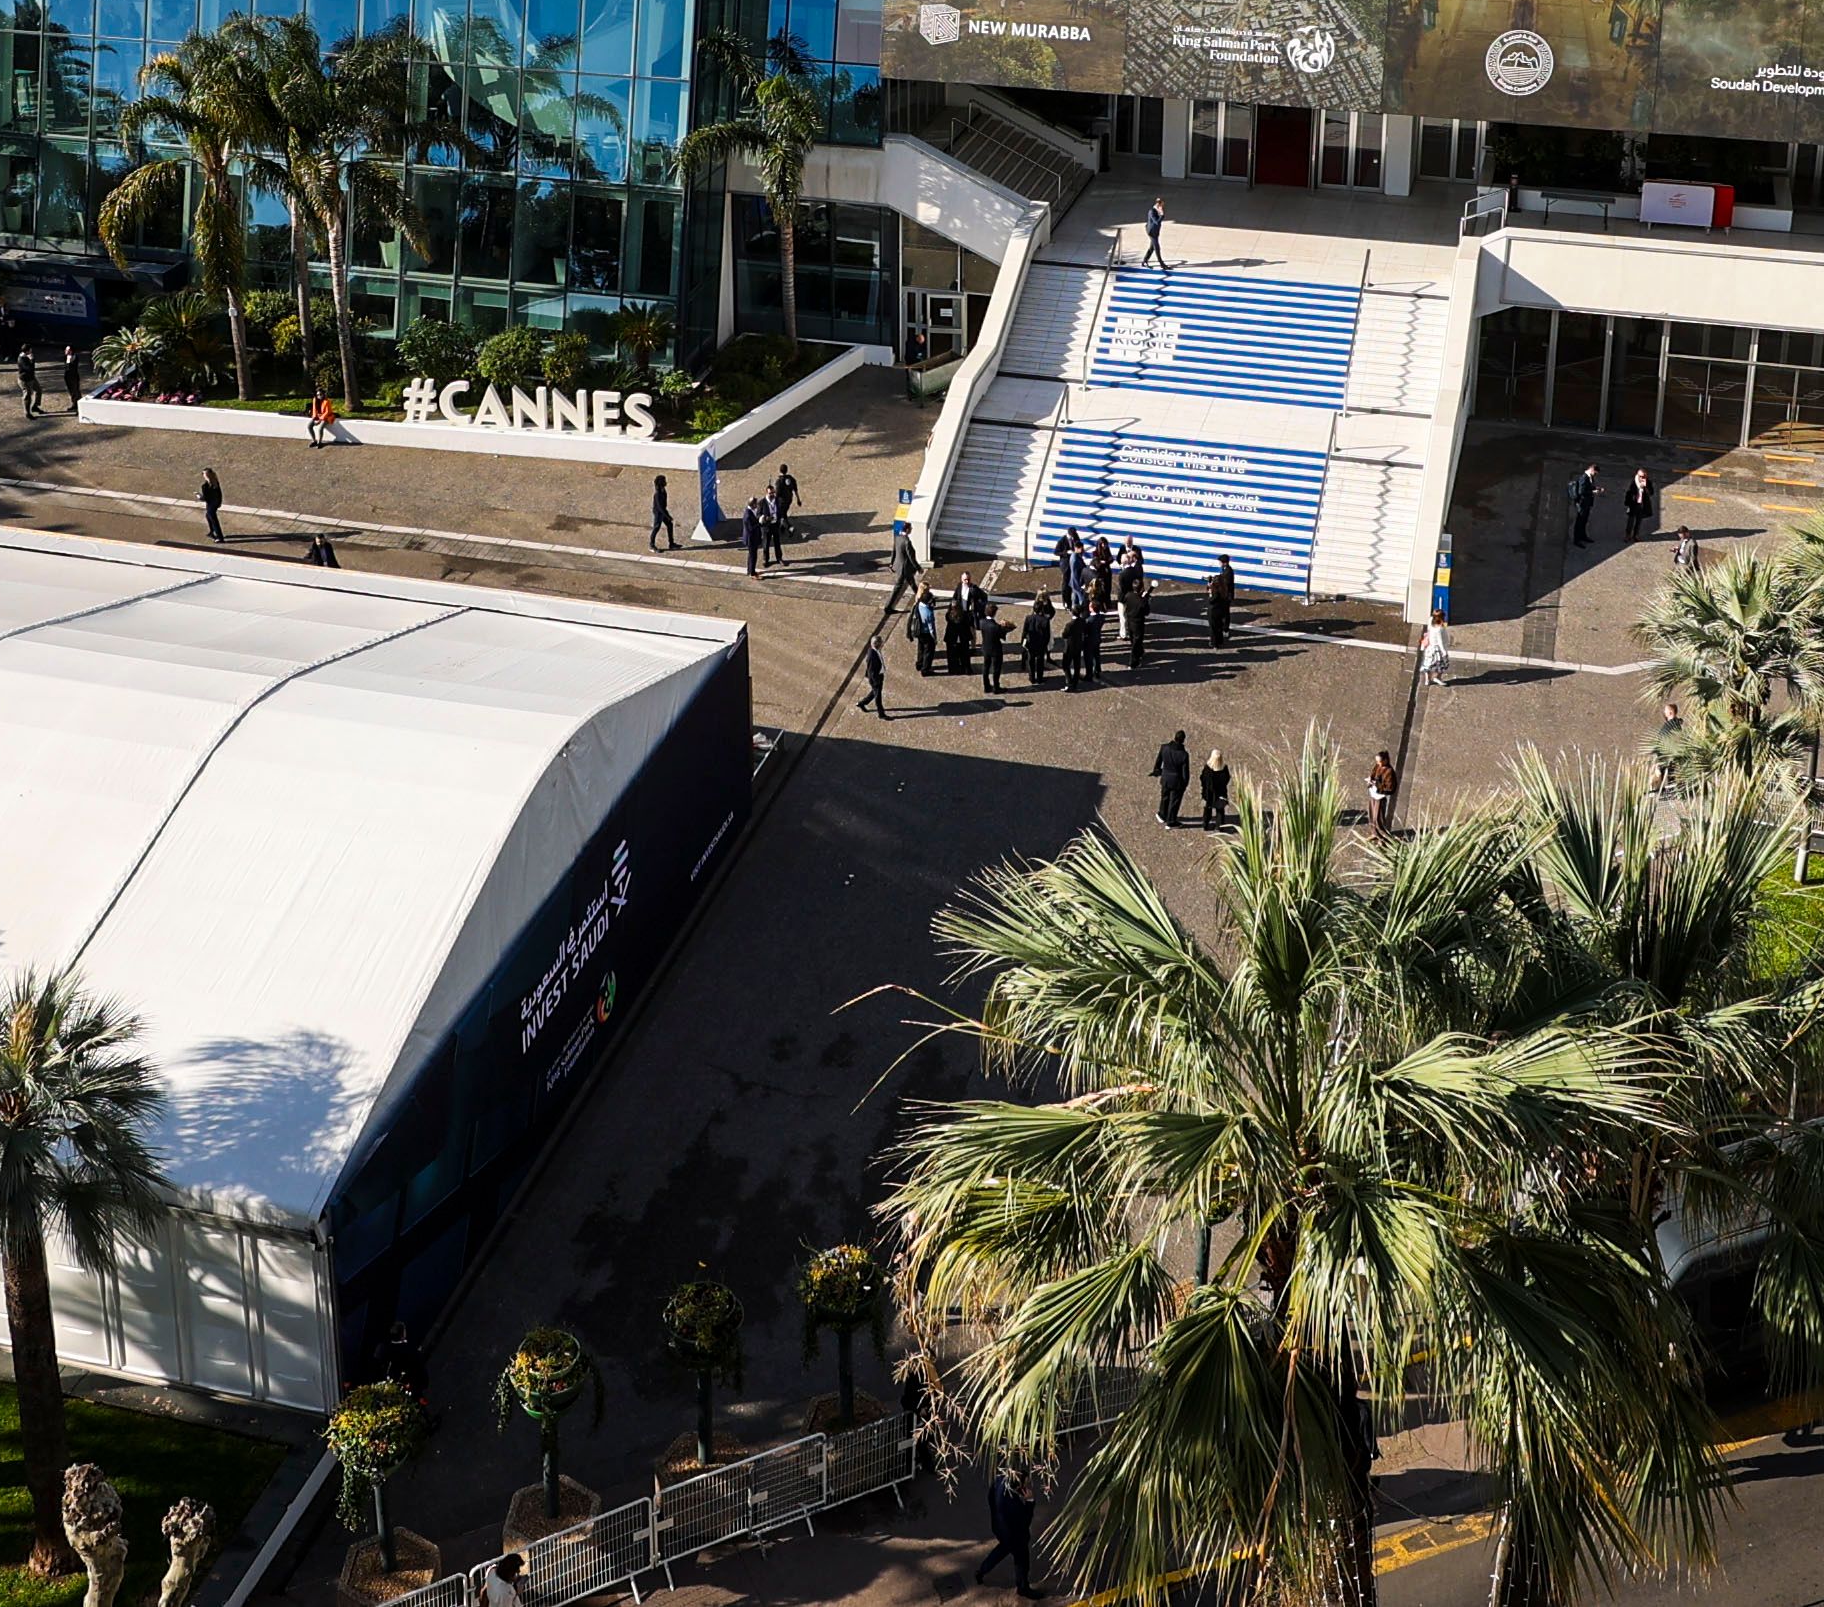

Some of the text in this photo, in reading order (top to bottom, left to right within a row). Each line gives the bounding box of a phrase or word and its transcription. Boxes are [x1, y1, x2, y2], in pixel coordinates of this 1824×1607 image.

[968, 19, 1091, 41] NEW MURABBA
[1172, 34, 1282, 54] King Salman Park
[1209, 49, 1279, 64] Foundation
[1755, 64, 1801, 78] للتطوير
[1711, 78, 1760, 91] Soudah
[402, 377, 658, 438] #CANNES
[1119, 444, 1182, 467] Consider
[1182, 450, 1208, 470] this
[1223, 454, 1249, 474] live
[1110, 480, 1261, 513] demo of why we exist
[522, 908, 609, 1055] INVEST SAUDI
